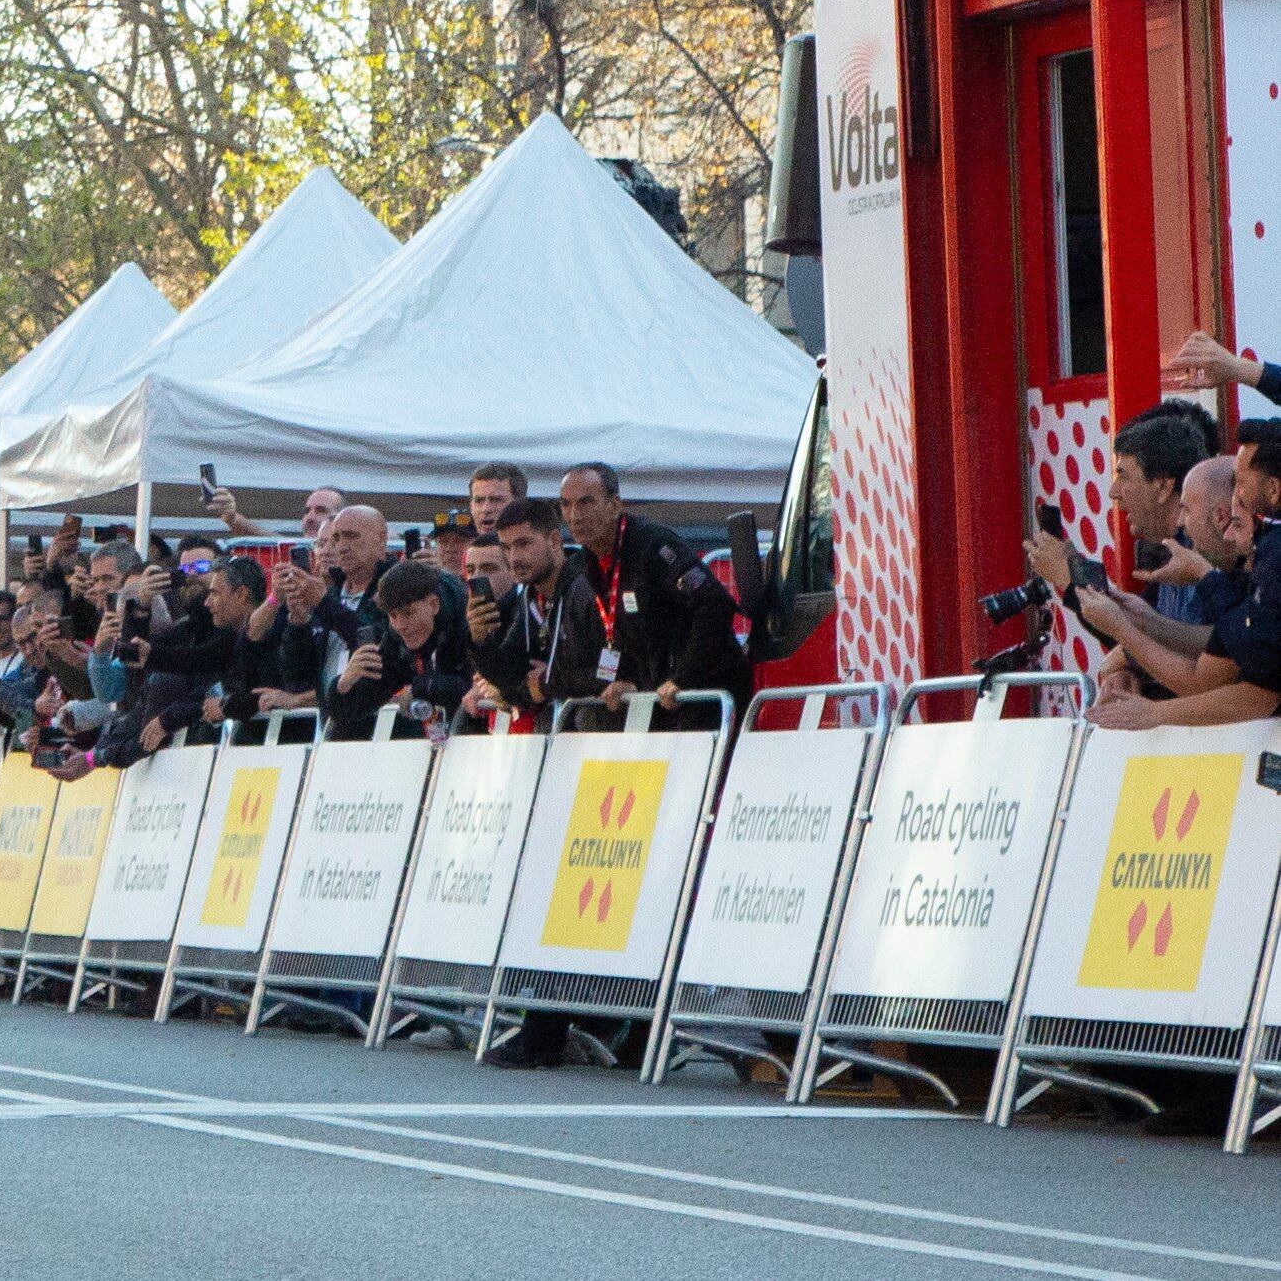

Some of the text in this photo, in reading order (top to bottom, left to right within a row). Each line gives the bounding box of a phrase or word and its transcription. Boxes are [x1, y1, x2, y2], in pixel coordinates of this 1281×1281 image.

[827, 85, 899, 192] Volta
[310, 790, 404, 833] Rennradfahren
[441, 790, 513, 847] Road cycling
[725, 791, 832, 844] Rennradfahren
[895, 787, 1021, 855] Road cycling
[568, 836, 645, 868] CATALUNYA
[1112, 851, 1213, 890] CATALUNYA
[299, 857, 382, 901] in Katalonien
[427, 859, 493, 905] in Catalonia
[712, 871, 807, 925] in Katalonien
[878, 873, 995, 929] in Catalonia
